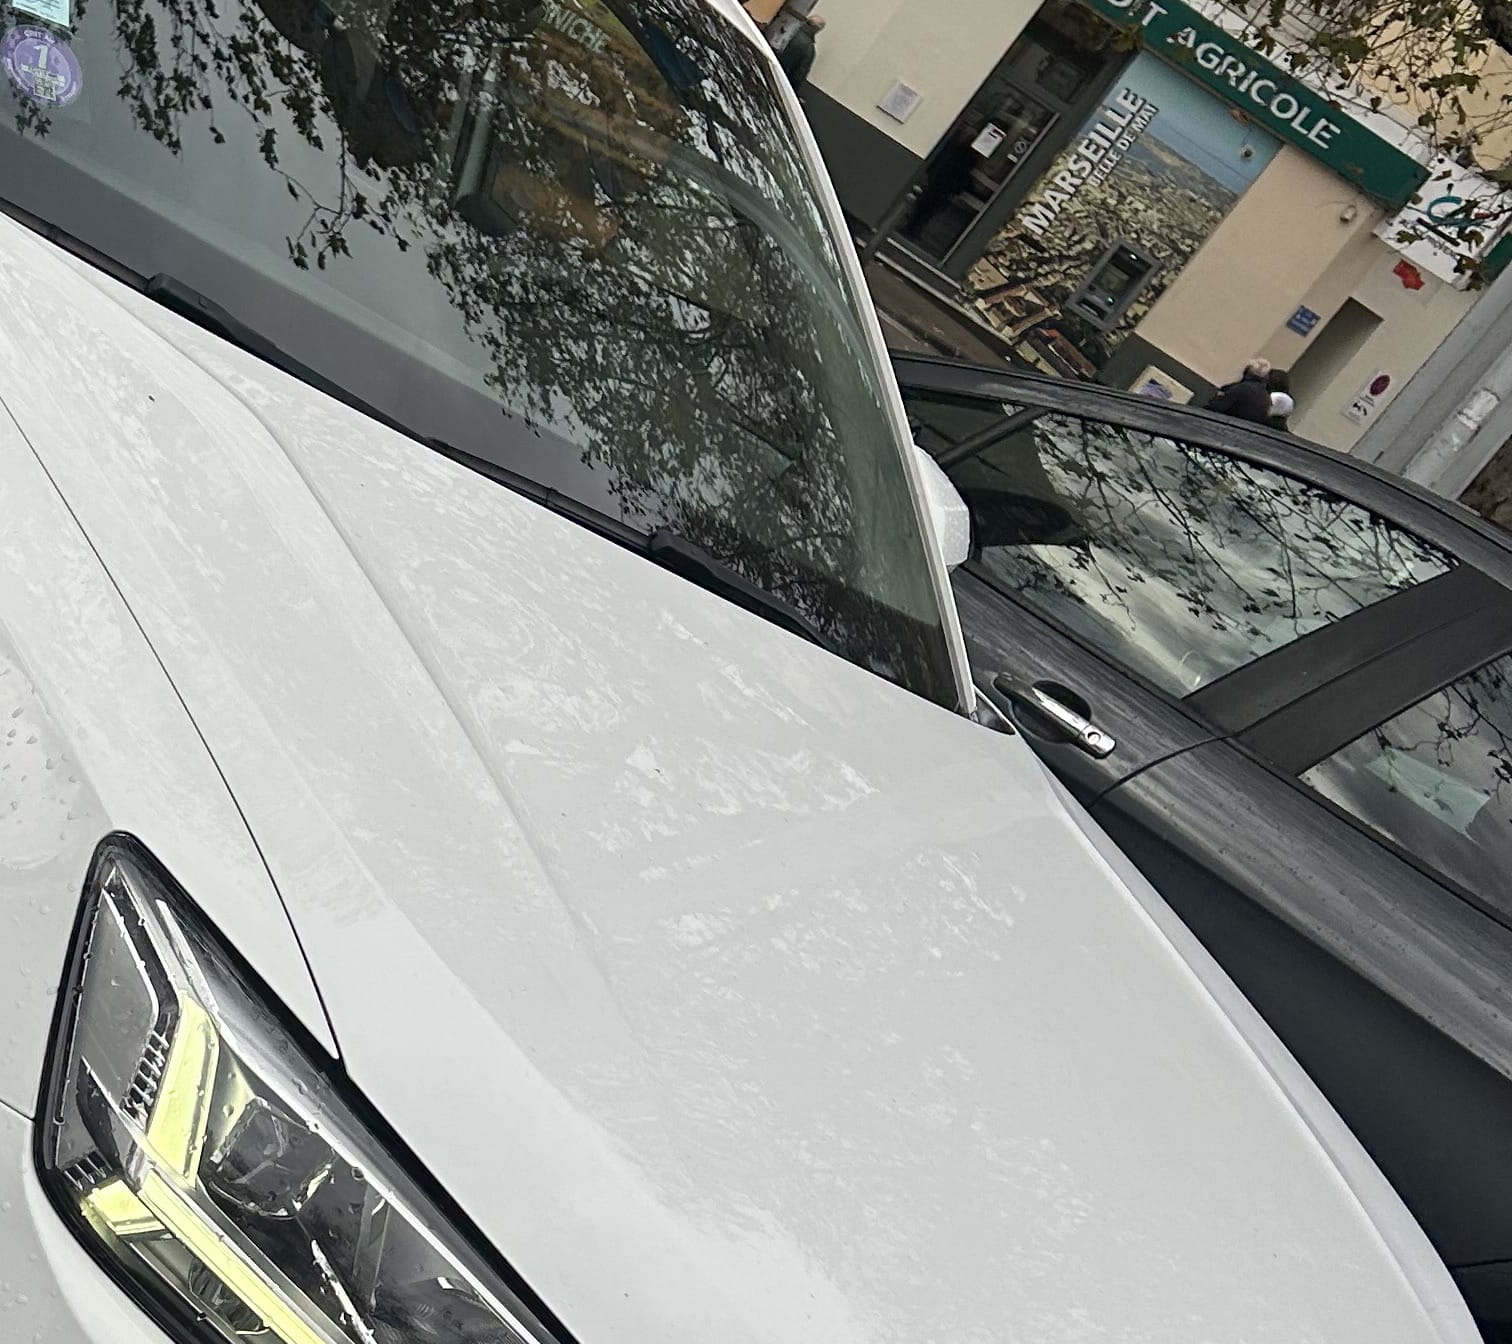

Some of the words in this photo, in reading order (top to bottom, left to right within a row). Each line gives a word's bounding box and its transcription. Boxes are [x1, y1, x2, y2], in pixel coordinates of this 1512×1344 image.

[33, 44, 48, 69] 1
[1165, 26, 1341, 150] AGRICOLE
[1022, 87, 1147, 236] MARSEILLE
[1088, 150, 1123, 188] BELLE
[1117, 127, 1136, 152] DE
[1132, 103, 1160, 134] MAI
